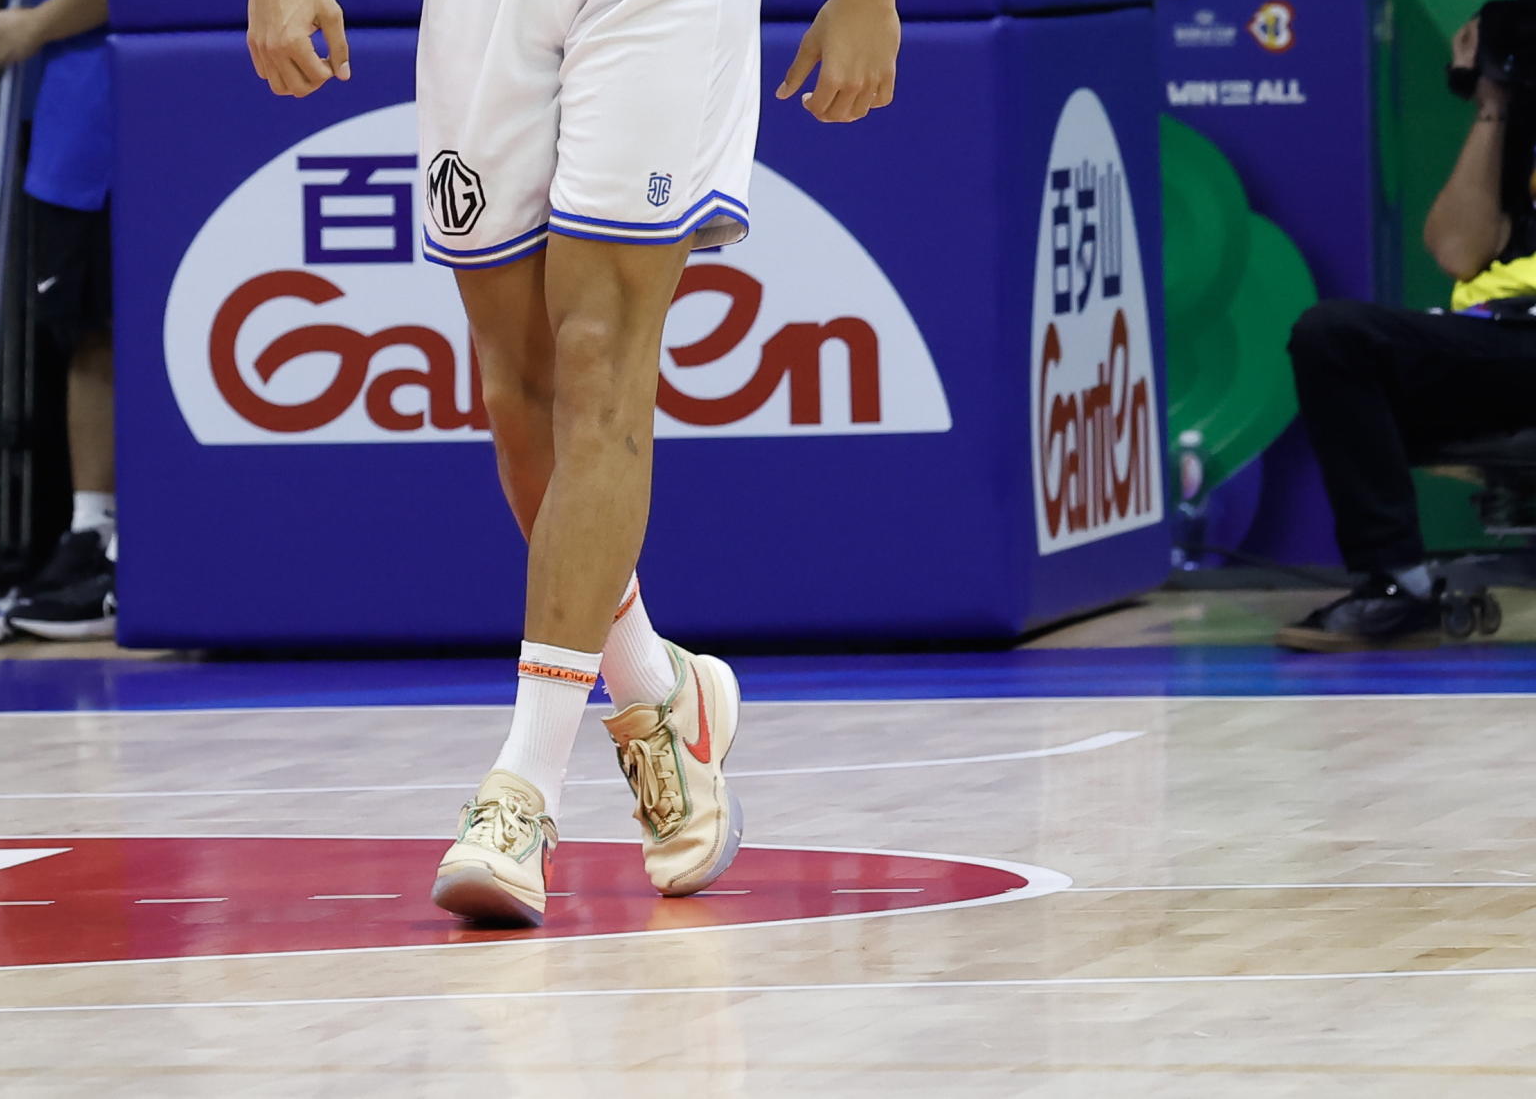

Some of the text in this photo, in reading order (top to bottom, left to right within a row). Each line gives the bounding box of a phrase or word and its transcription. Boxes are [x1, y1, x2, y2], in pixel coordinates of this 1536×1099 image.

[1255, 79, 1307, 104] ALL
[429, 157, 478, 229] MG
[1051, 158, 1122, 316] 百岁山
[208, 264, 881, 434] Gaen
